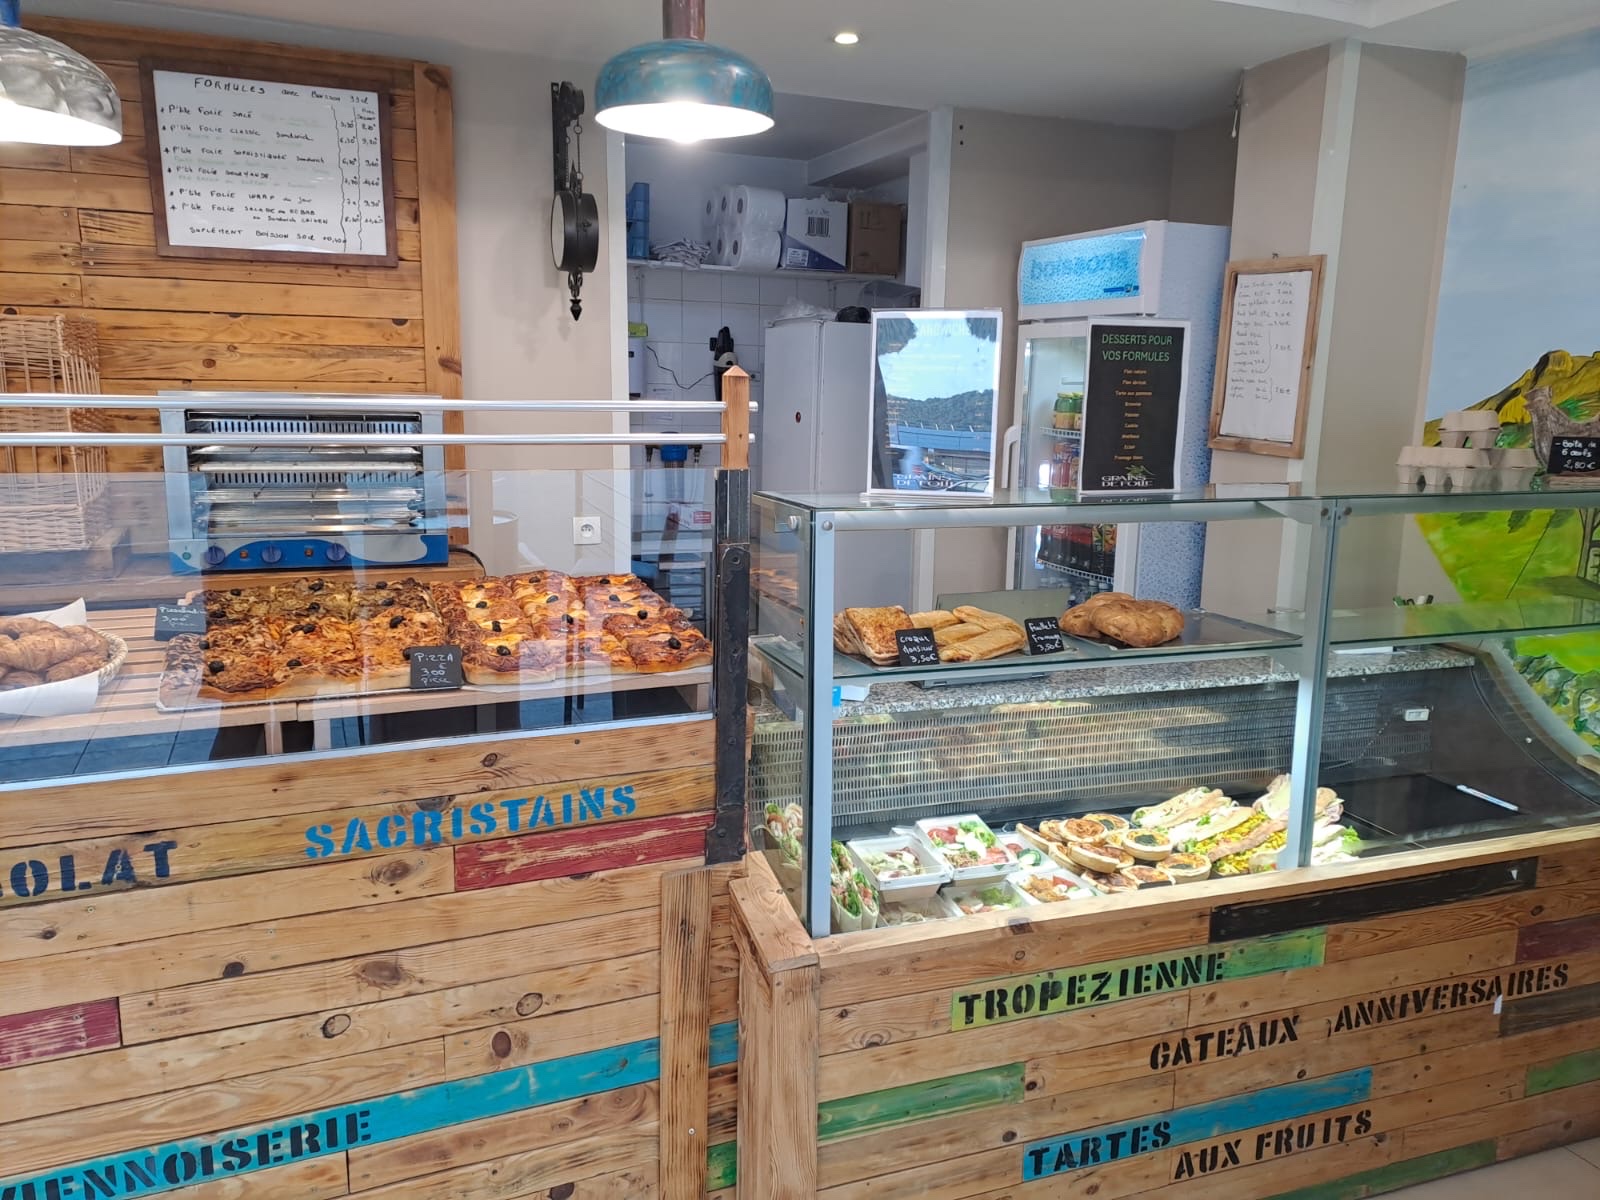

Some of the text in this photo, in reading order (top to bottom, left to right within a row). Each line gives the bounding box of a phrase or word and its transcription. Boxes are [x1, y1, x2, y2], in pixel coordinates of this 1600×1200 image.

[1101, 333, 1173, 345] DESSERTS POUR
[1101, 350, 1170, 362] VOS FORMULES
[1561, 447, 1569, 456] 6
[304, 785, 637, 859] SACRISTAINS
[0, 841, 178, 898] OLAT
[958, 952, 1225, 1025] TROPEZIENNE
[1150, 963, 1569, 1071] GATEAUX ANNIVERSAIRES
[1028, 1120, 1172, 1177] TARTES
[1174, 1109, 1372, 1181] AUX FRUITS
